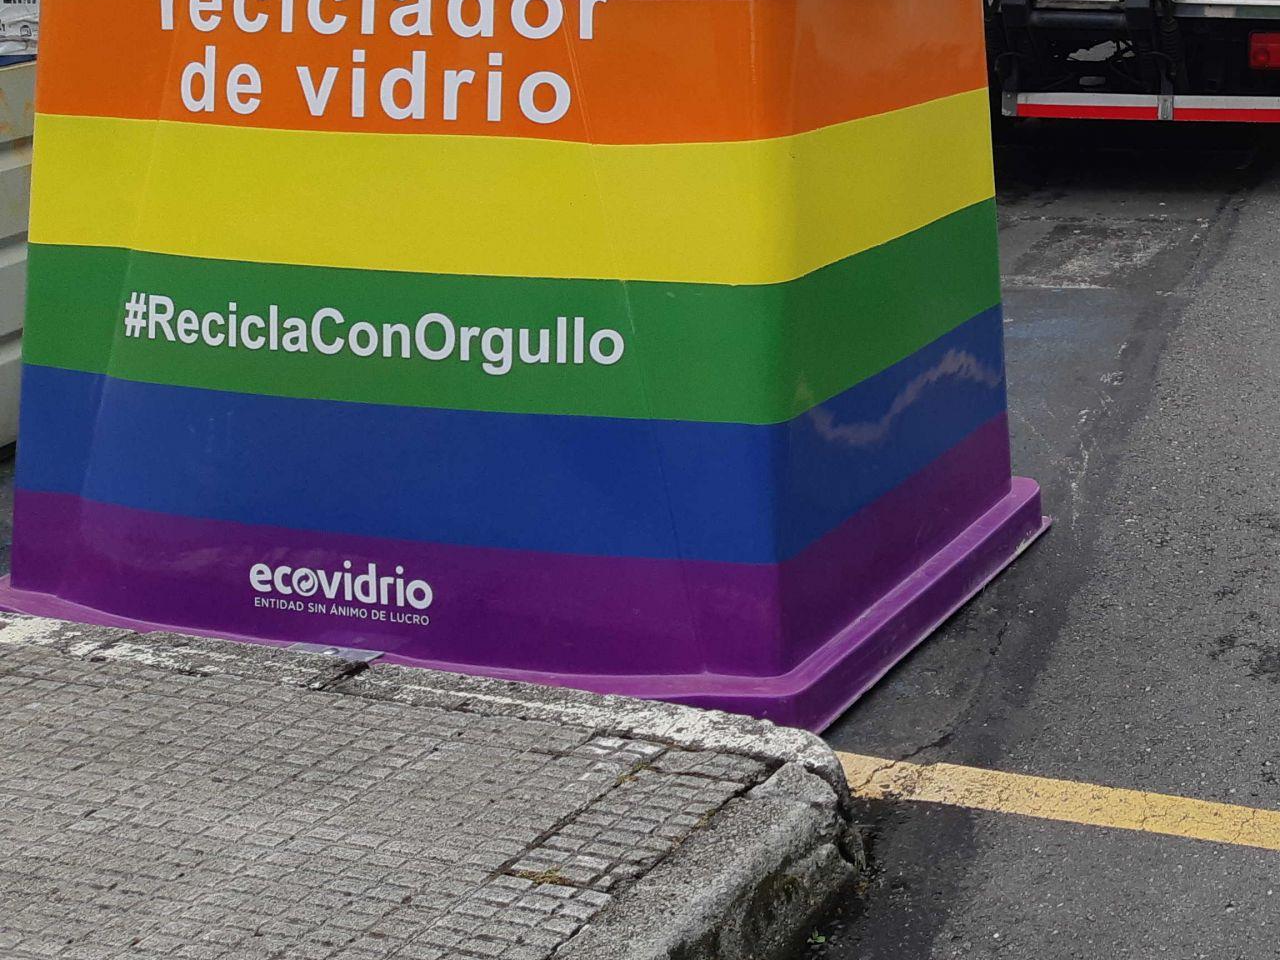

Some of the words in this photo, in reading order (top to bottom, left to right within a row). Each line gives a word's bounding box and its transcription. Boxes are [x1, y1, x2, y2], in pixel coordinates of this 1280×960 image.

[180, 45, 263, 113] de
[296, 50, 572, 123] vidrio
[124, 291, 625, 376] #ReciclaConOrgullo
[249, 559, 434, 610] ecovidrio
[254, 597, 305, 612] ENTIDAD
[307, 602, 327, 614] SIN
[329, 603, 368, 619] ÁNIMO
[371, 609, 387, 621] DE
[389, 612, 430, 626] LUCRO
